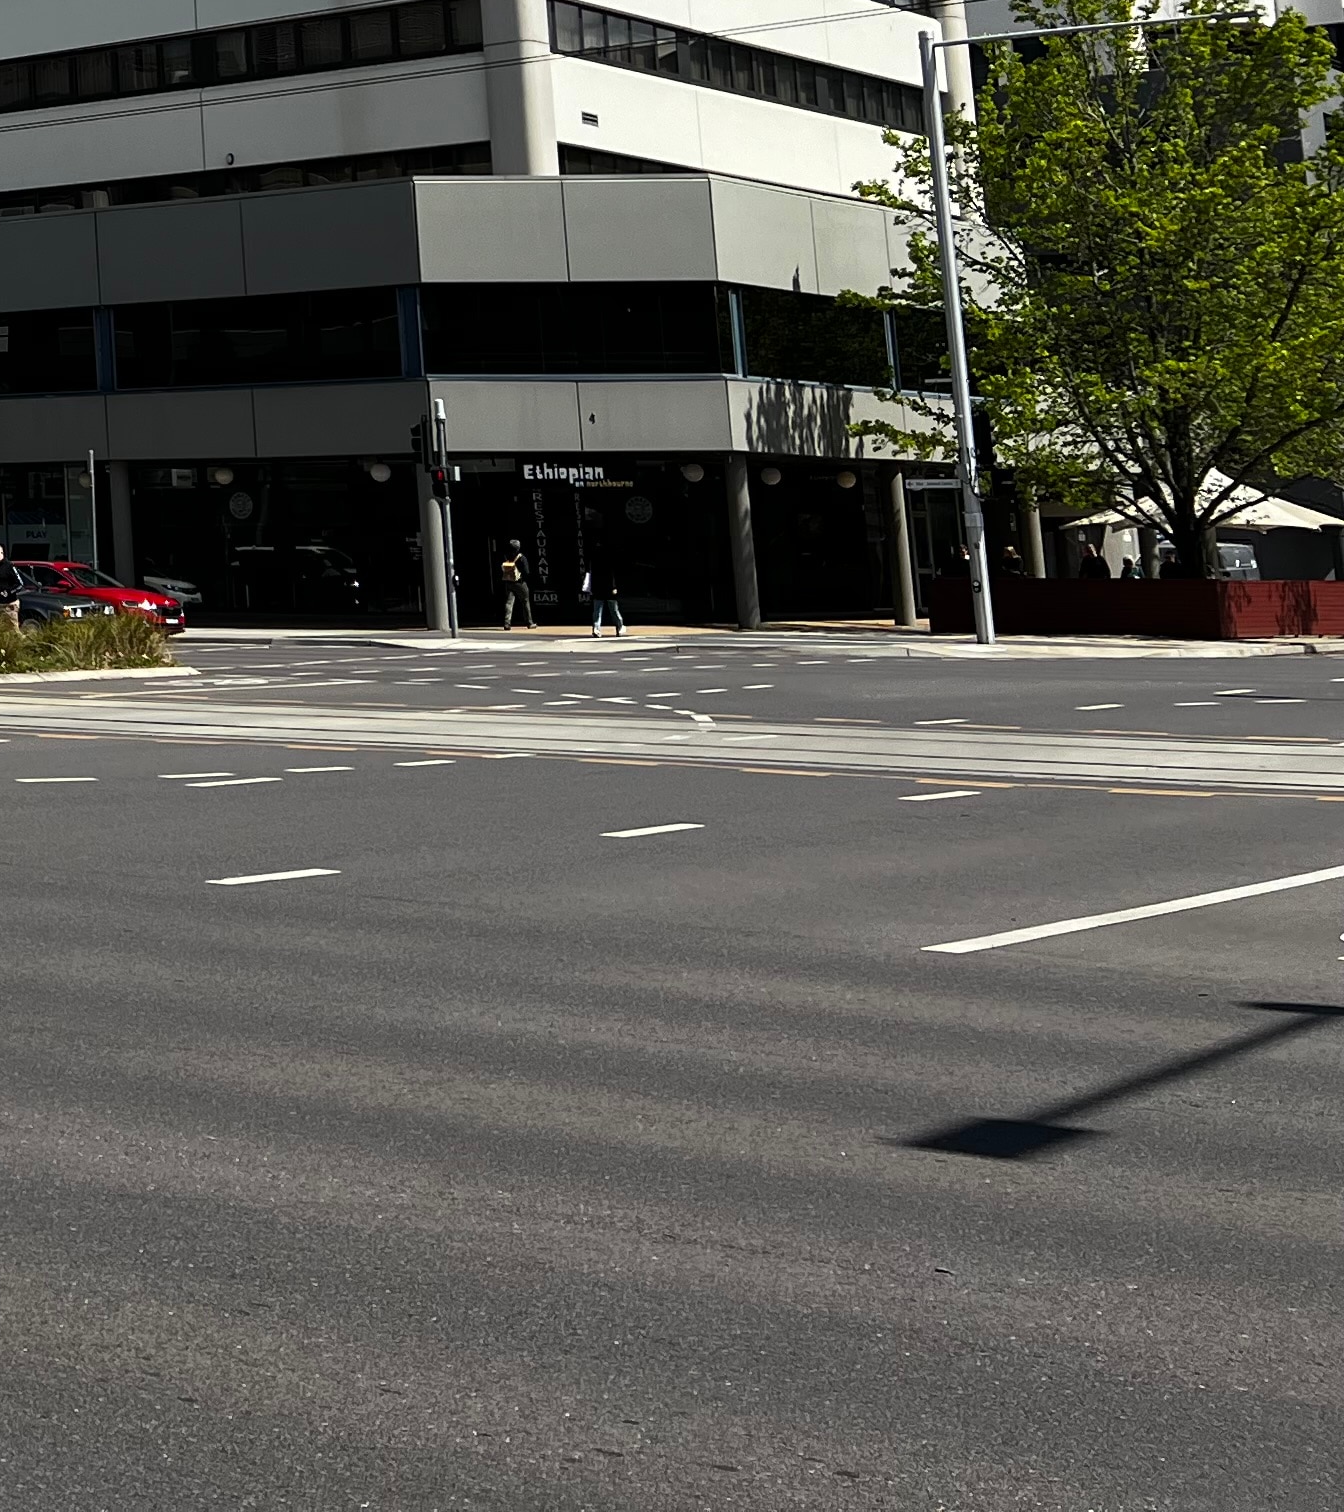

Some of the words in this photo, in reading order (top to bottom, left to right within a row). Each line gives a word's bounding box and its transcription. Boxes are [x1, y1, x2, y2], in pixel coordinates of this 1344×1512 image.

[523, 463, 605, 484] Ethiopian
[26, 530, 48, 538] PLAY
[532, 492, 549, 584] RESTAURANT
[533, 593, 559, 603] BAR
